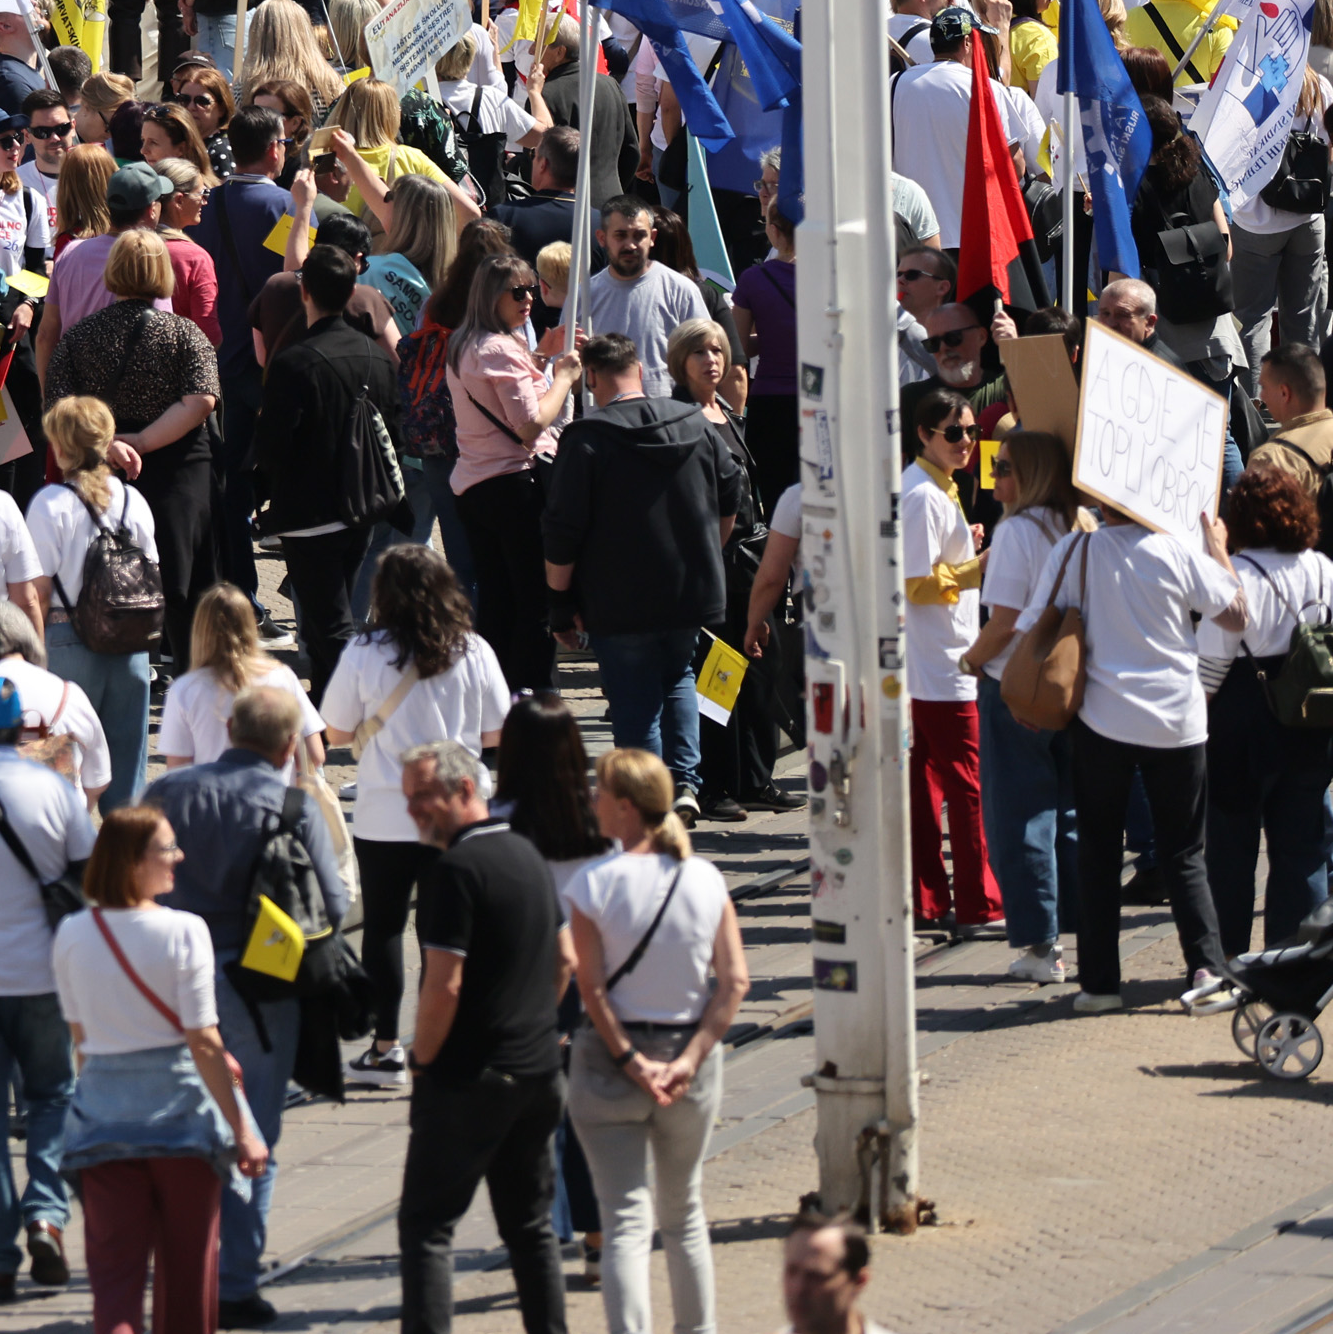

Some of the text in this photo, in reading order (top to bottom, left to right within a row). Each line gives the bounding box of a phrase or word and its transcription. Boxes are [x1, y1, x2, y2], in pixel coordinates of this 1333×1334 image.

[391, 1, 455, 68] MEDICINSKE SESTRE?
[392, 30, 413, 56] ZAŠTO
[412, 23, 422, 36] SE
[398, 19, 452, 74] SISTEMATIZACIJA
[405, 31, 452, 81] RADNIH MJESTA
[1088, 349, 1221, 472] A GDJE JE
[1087, 409, 1218, 538] TOPLI OBROK
